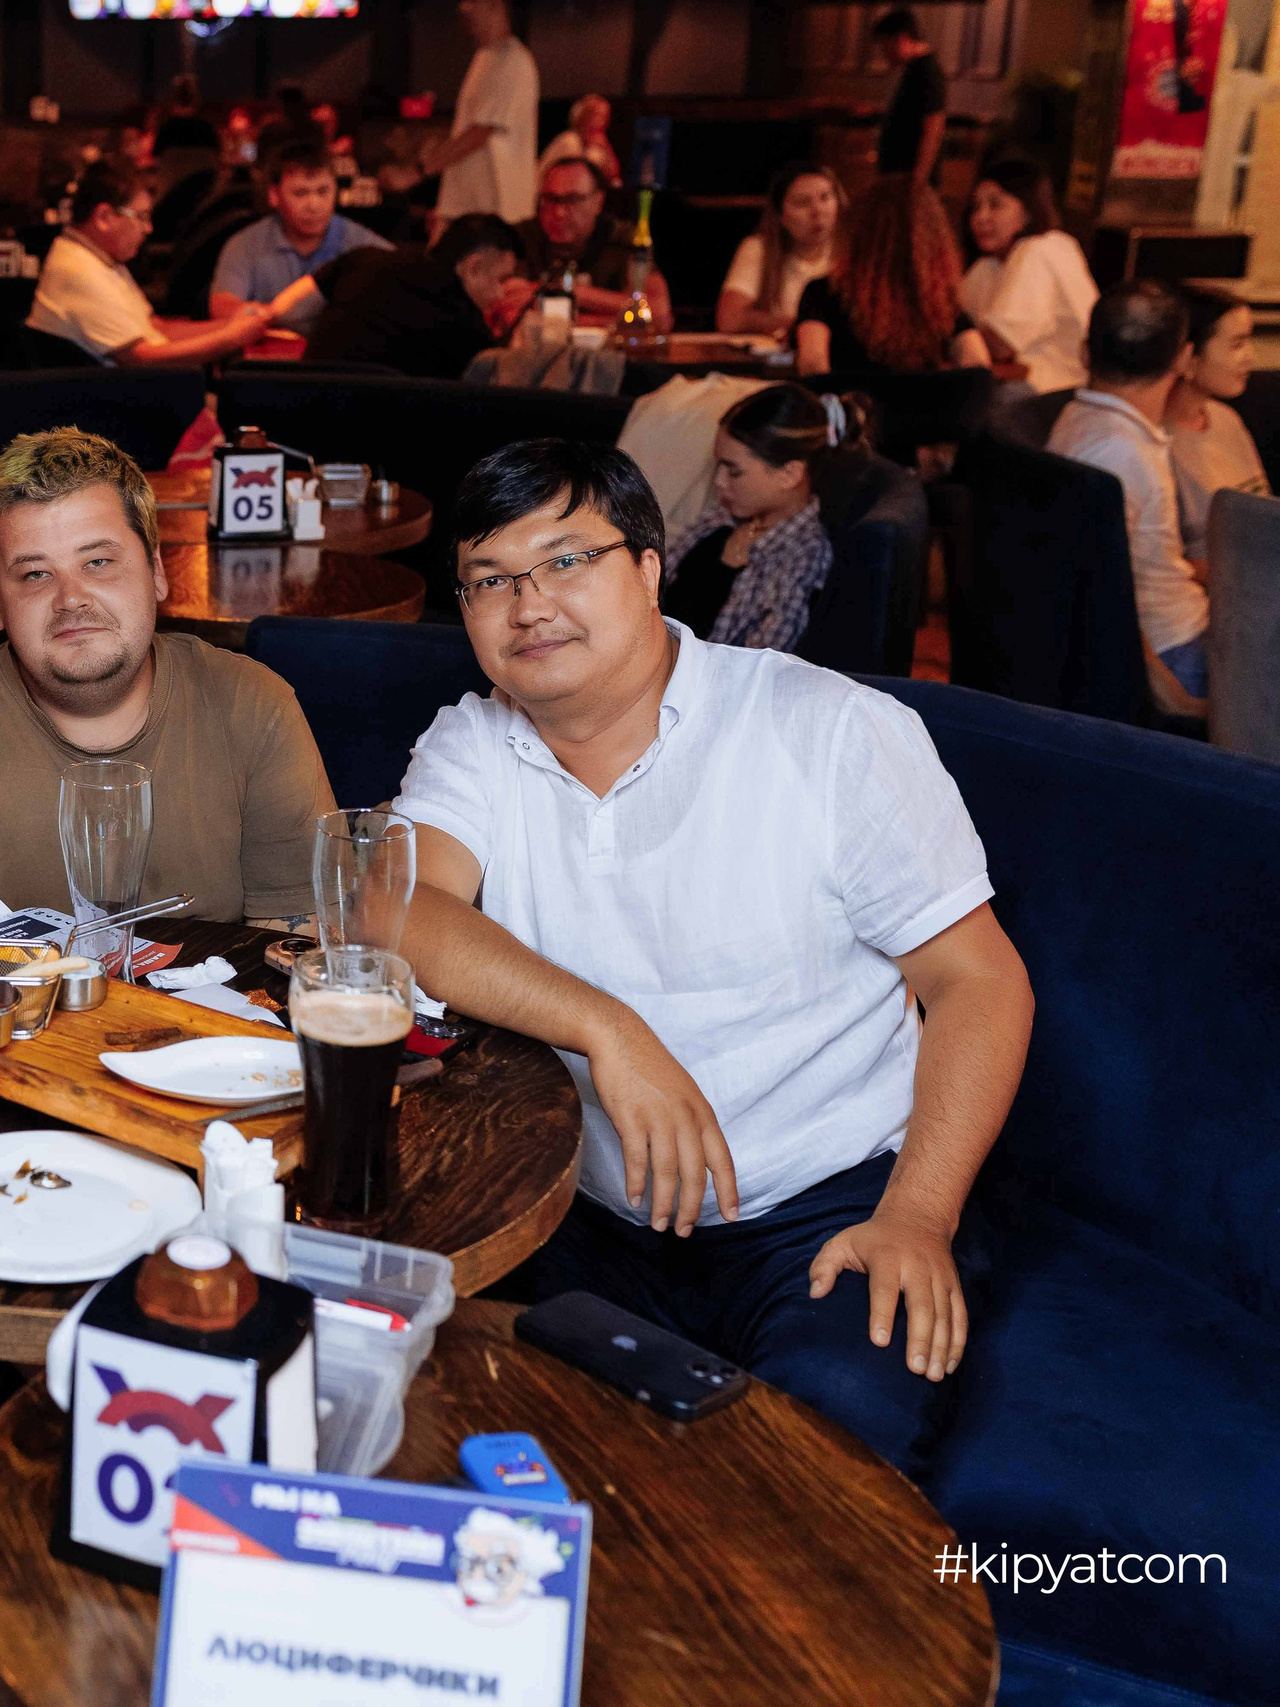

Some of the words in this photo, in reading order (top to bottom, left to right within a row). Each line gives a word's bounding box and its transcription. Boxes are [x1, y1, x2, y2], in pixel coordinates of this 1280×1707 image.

[233, 496, 273, 521] 05
[98, 1453, 176, 1524] 0
[208, 1636, 499, 1697] ЛЮЦИФЕРЧИКИ
